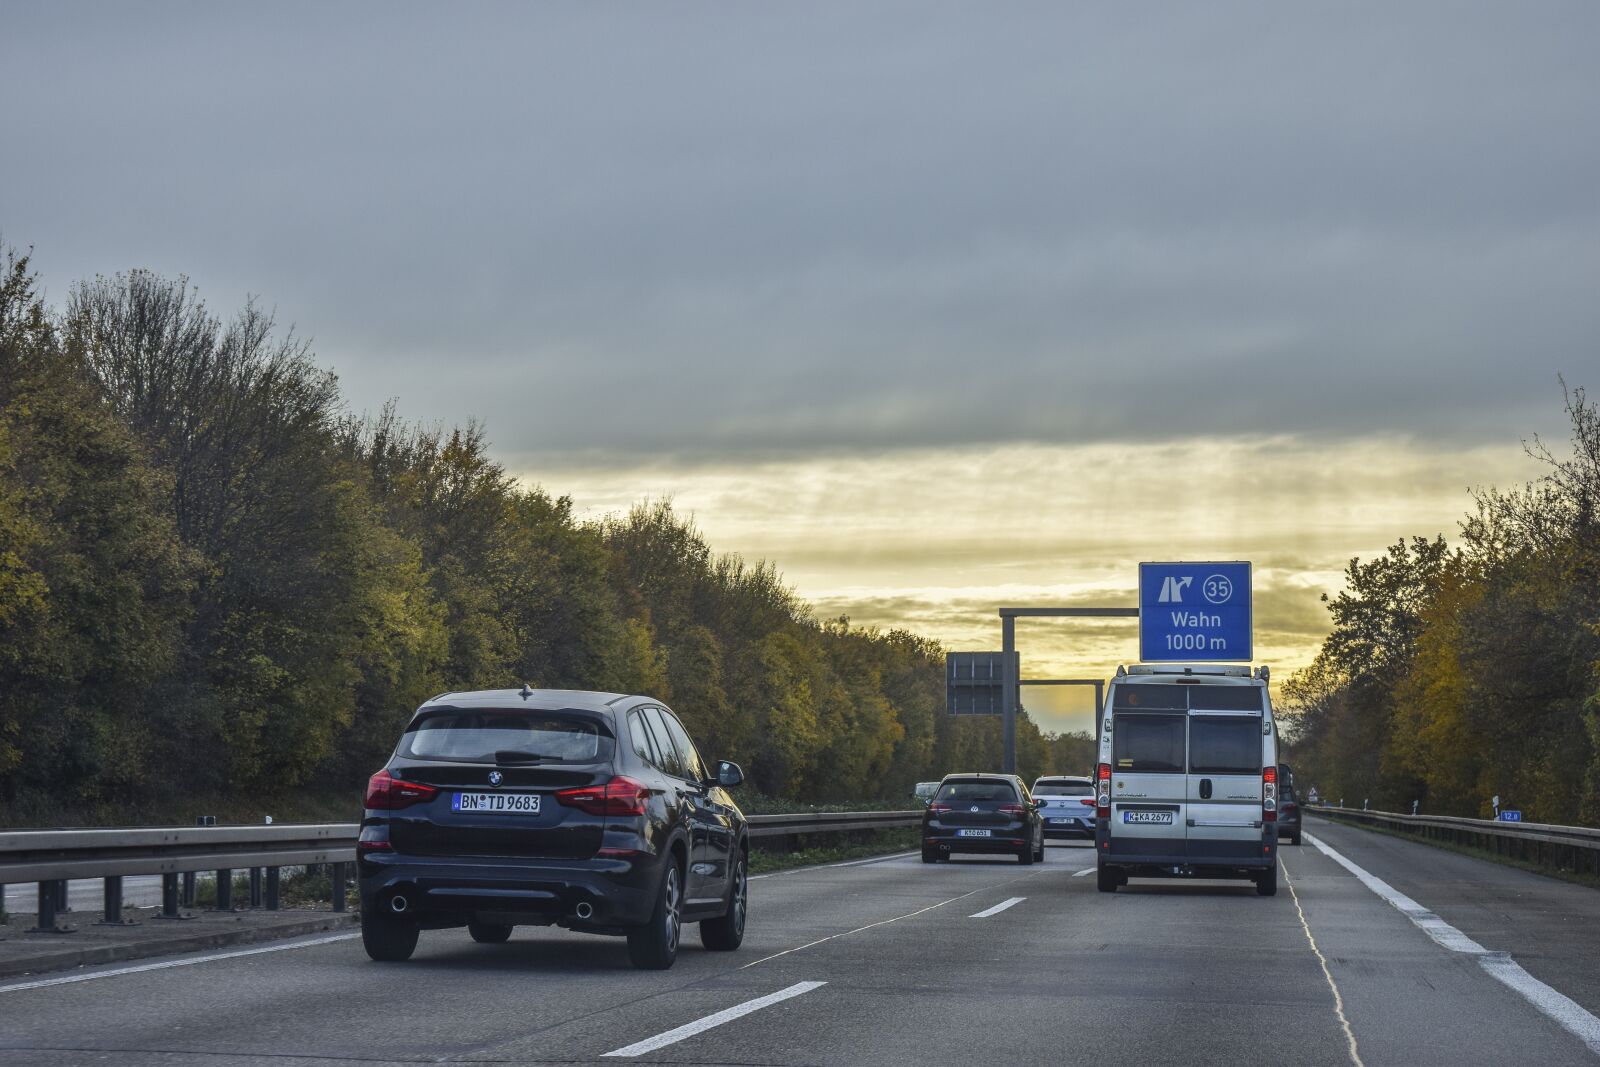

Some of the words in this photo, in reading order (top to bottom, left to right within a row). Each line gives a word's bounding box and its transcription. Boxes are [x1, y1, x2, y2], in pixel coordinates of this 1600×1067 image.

[1207, 581, 1228, 597] 35
[1171, 611, 1221, 627] Wahn
[1166, 634, 1205, 650] 1000
[1210, 638, 1226, 650] m
[461, 794, 479, 809] BN
[488, 795, 505, 810] TD
[507, 796, 539, 811] 9683
[1151, 813, 1170, 821] 2677
